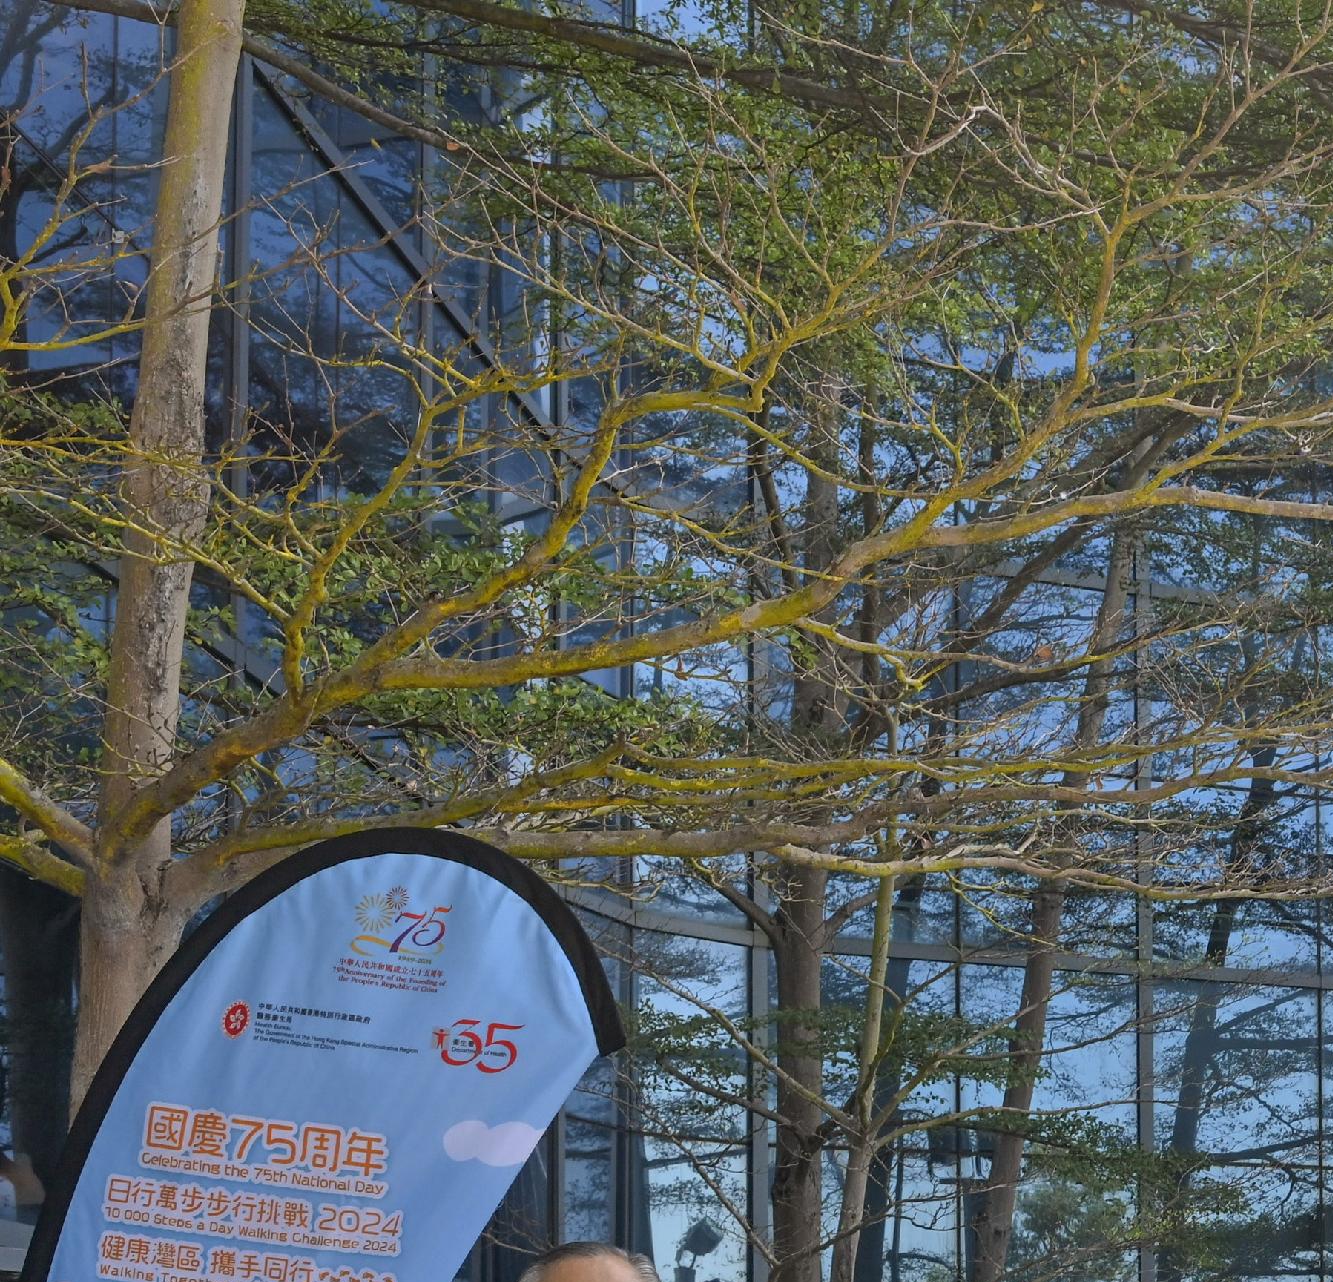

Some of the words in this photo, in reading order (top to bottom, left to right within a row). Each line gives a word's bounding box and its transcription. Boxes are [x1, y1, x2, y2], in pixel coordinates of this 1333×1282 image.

[394, 904, 453, 953] 75
[146, 1105, 384, 1177] 國慶75周年
[142, 1152, 220, 1175] Celebrating
[224, 1164, 249, 1178] the
[255, 1167, 288, 1185] 75th
[292, 1174, 350, 1192] National
[355, 1181, 384, 1195] Day
[108, 1178, 309, 1229] 日行萬步步行挑戰
[319, 1207, 400, 1236] 2024
[197, 1222, 205, 1231] a
[100, 1264, 154, 1282] Walking
[101, 1235, 200, 1272] 健康灣區
